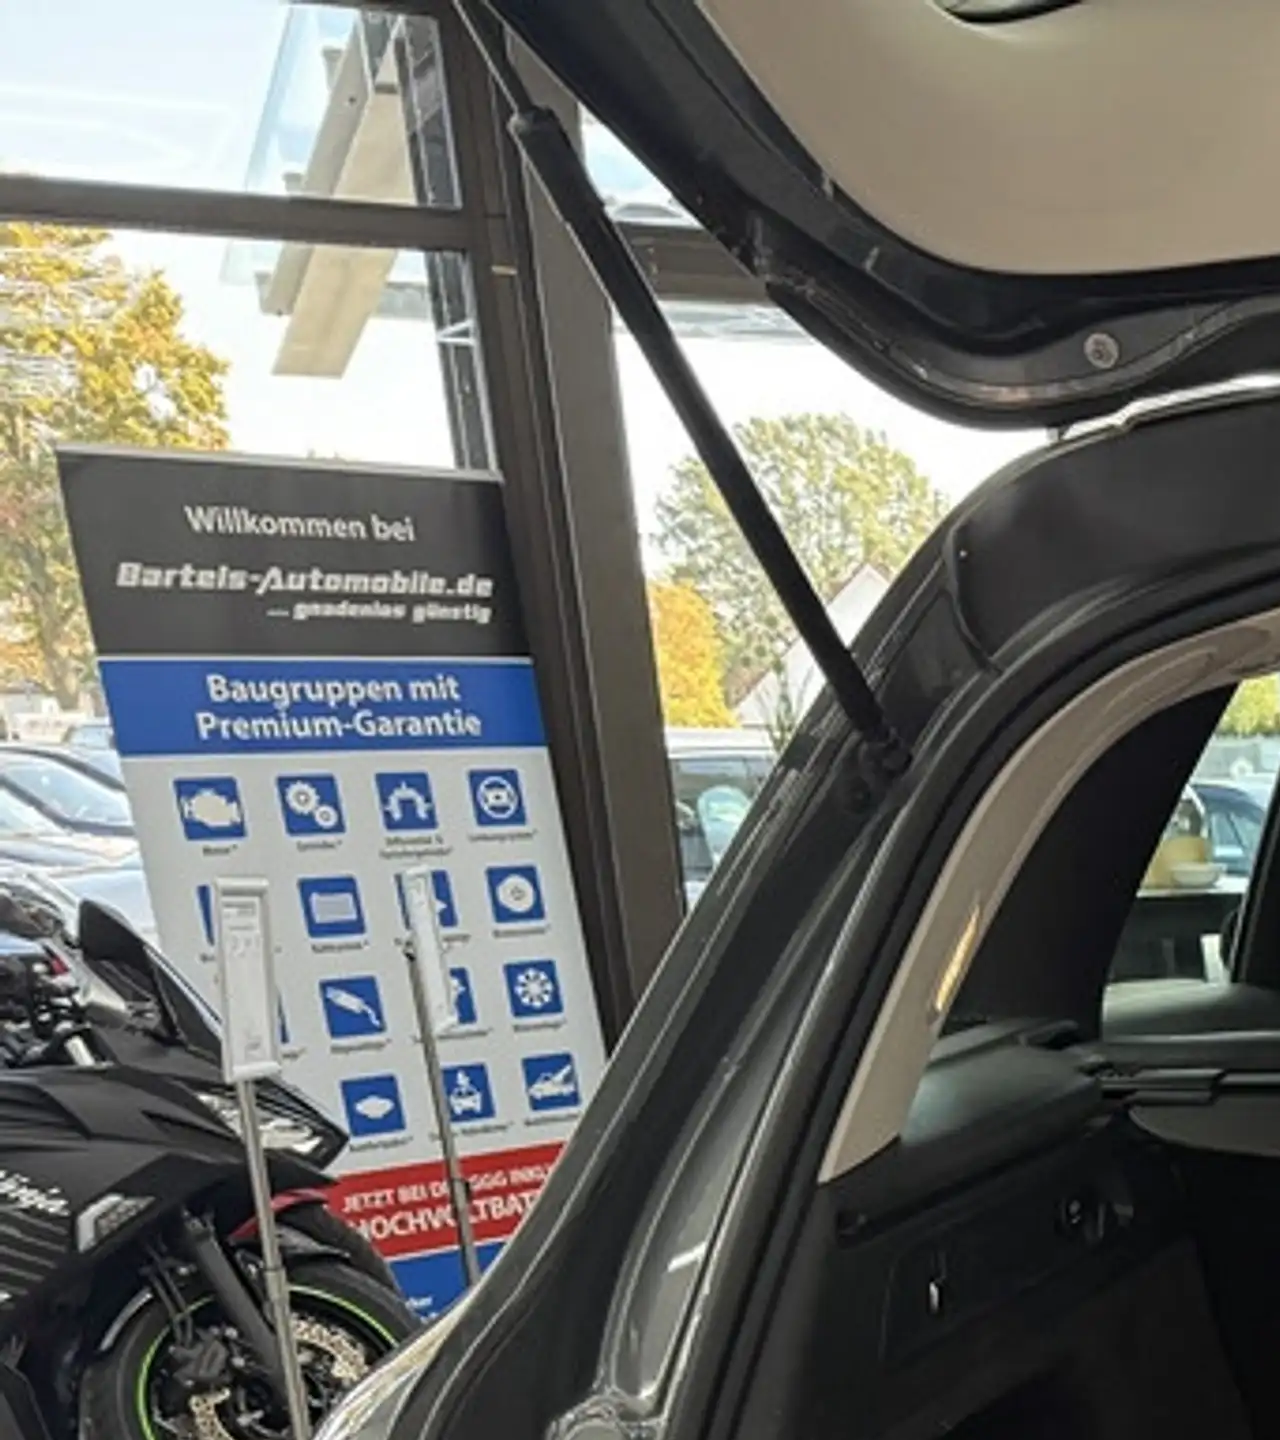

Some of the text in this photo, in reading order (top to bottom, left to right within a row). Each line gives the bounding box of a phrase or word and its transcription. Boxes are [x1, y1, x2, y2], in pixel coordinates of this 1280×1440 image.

[184, 505, 416, 542] Willkommen bei
[115, 561, 494, 598] Bartels-Automobile.de
[206, 674, 461, 710] Baugruppen mit
[195, 709, 484, 741] Premium-Garantie
